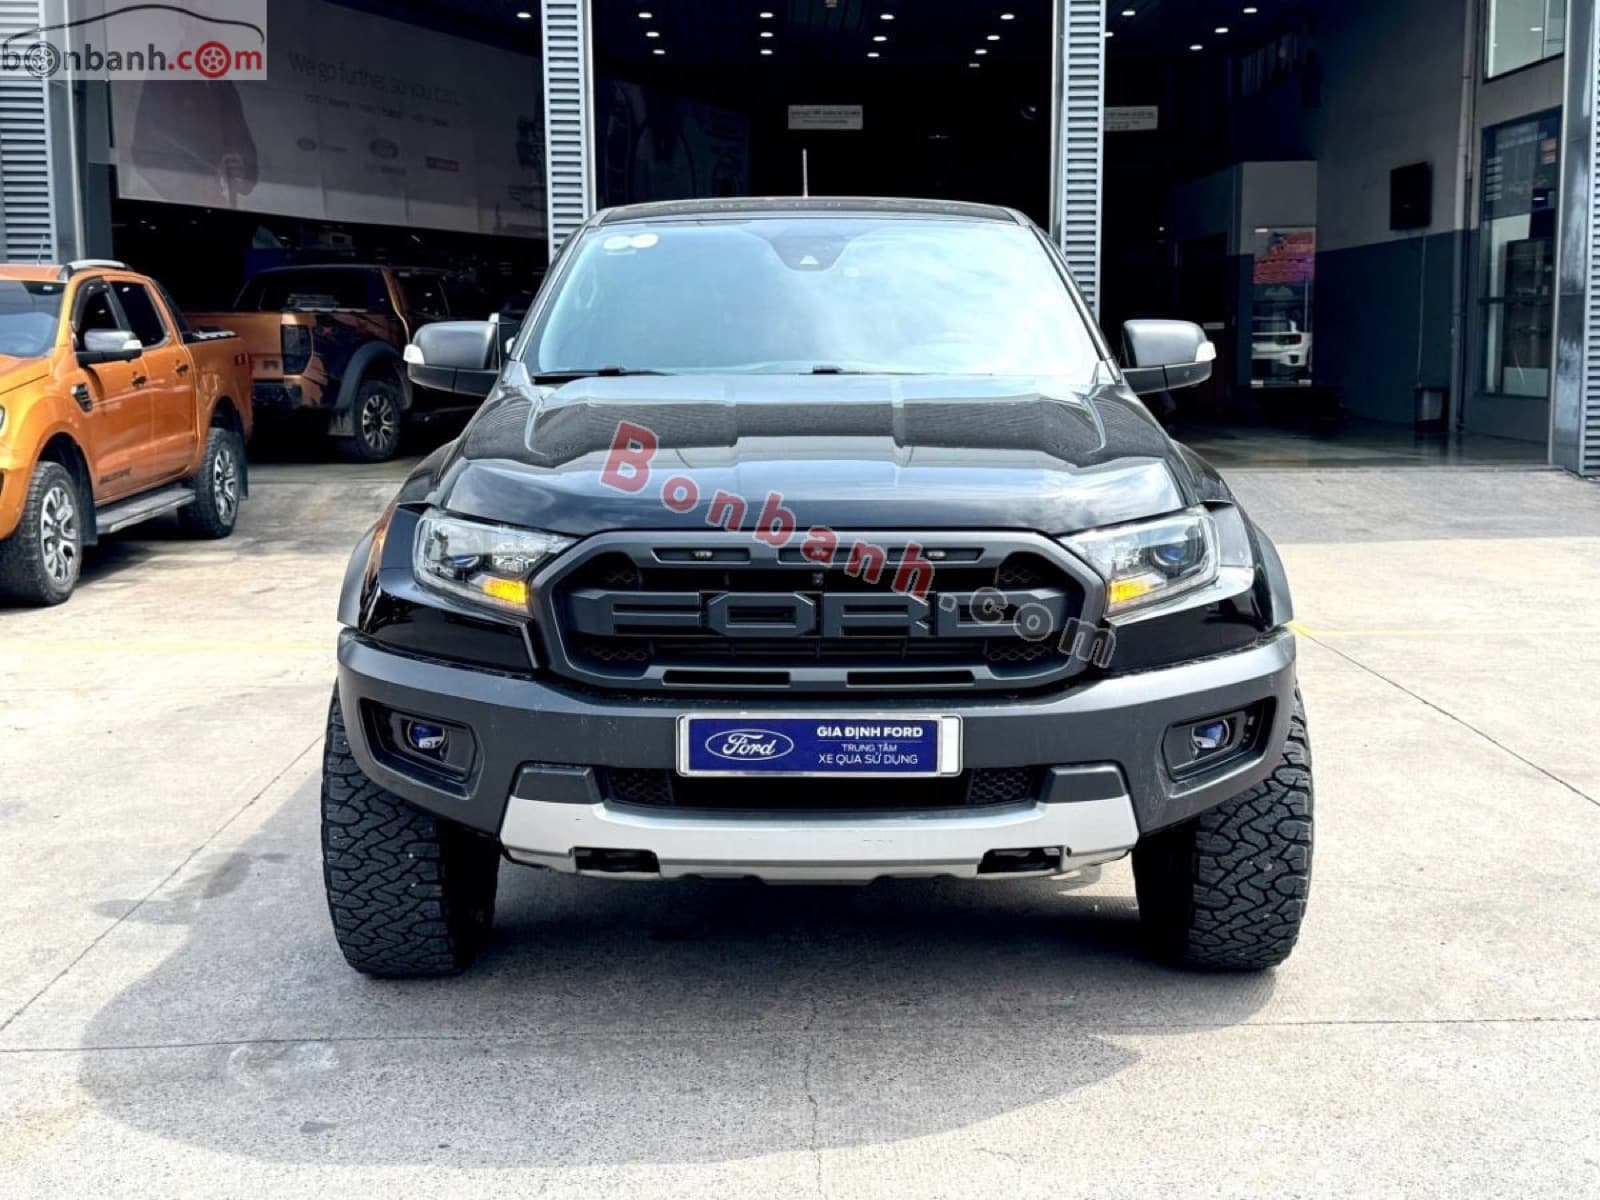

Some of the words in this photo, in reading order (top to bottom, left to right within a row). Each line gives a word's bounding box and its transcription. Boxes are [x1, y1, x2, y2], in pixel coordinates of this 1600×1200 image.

[570, 590, 1065, 638] FORD
[816, 726, 843, 738] GIA
[883, 726, 924, 738] FORD
[721, 732, 776, 756] Ford
[841, 743, 876, 753] TRUNG
[877, 741, 898, 752] TÂM
[819, 754, 834, 764] XE
[835, 754, 862, 766] QUA
[864, 751, 882, 764] SỬ
[883, 754, 918, 766] DỤNG
